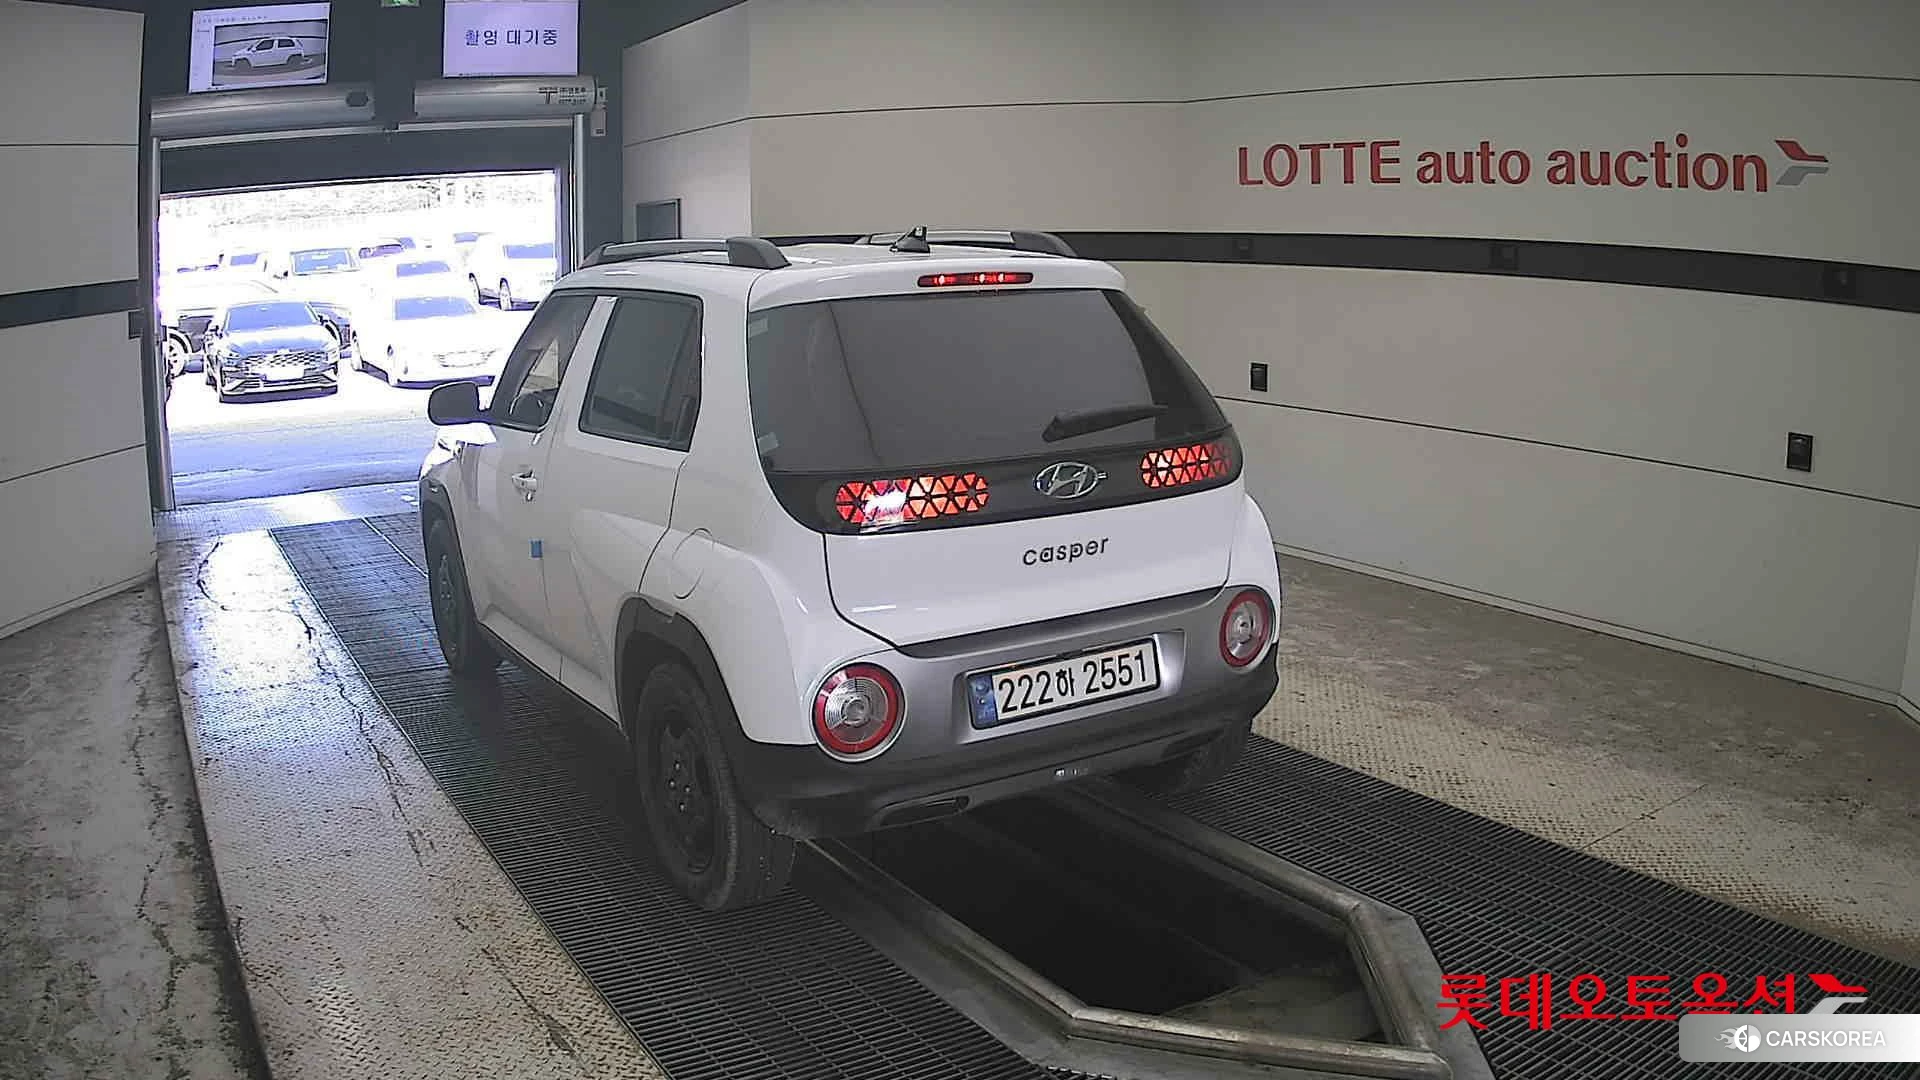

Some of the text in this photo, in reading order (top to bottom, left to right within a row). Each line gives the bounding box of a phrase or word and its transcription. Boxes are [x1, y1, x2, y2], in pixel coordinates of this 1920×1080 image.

[506, 29, 558, 46] 대기중
[1237, 133, 1768, 192] LOTTE auto auction
[1023, 537, 1109, 565] casper
[998, 649, 1146, 713] 222하 2551
